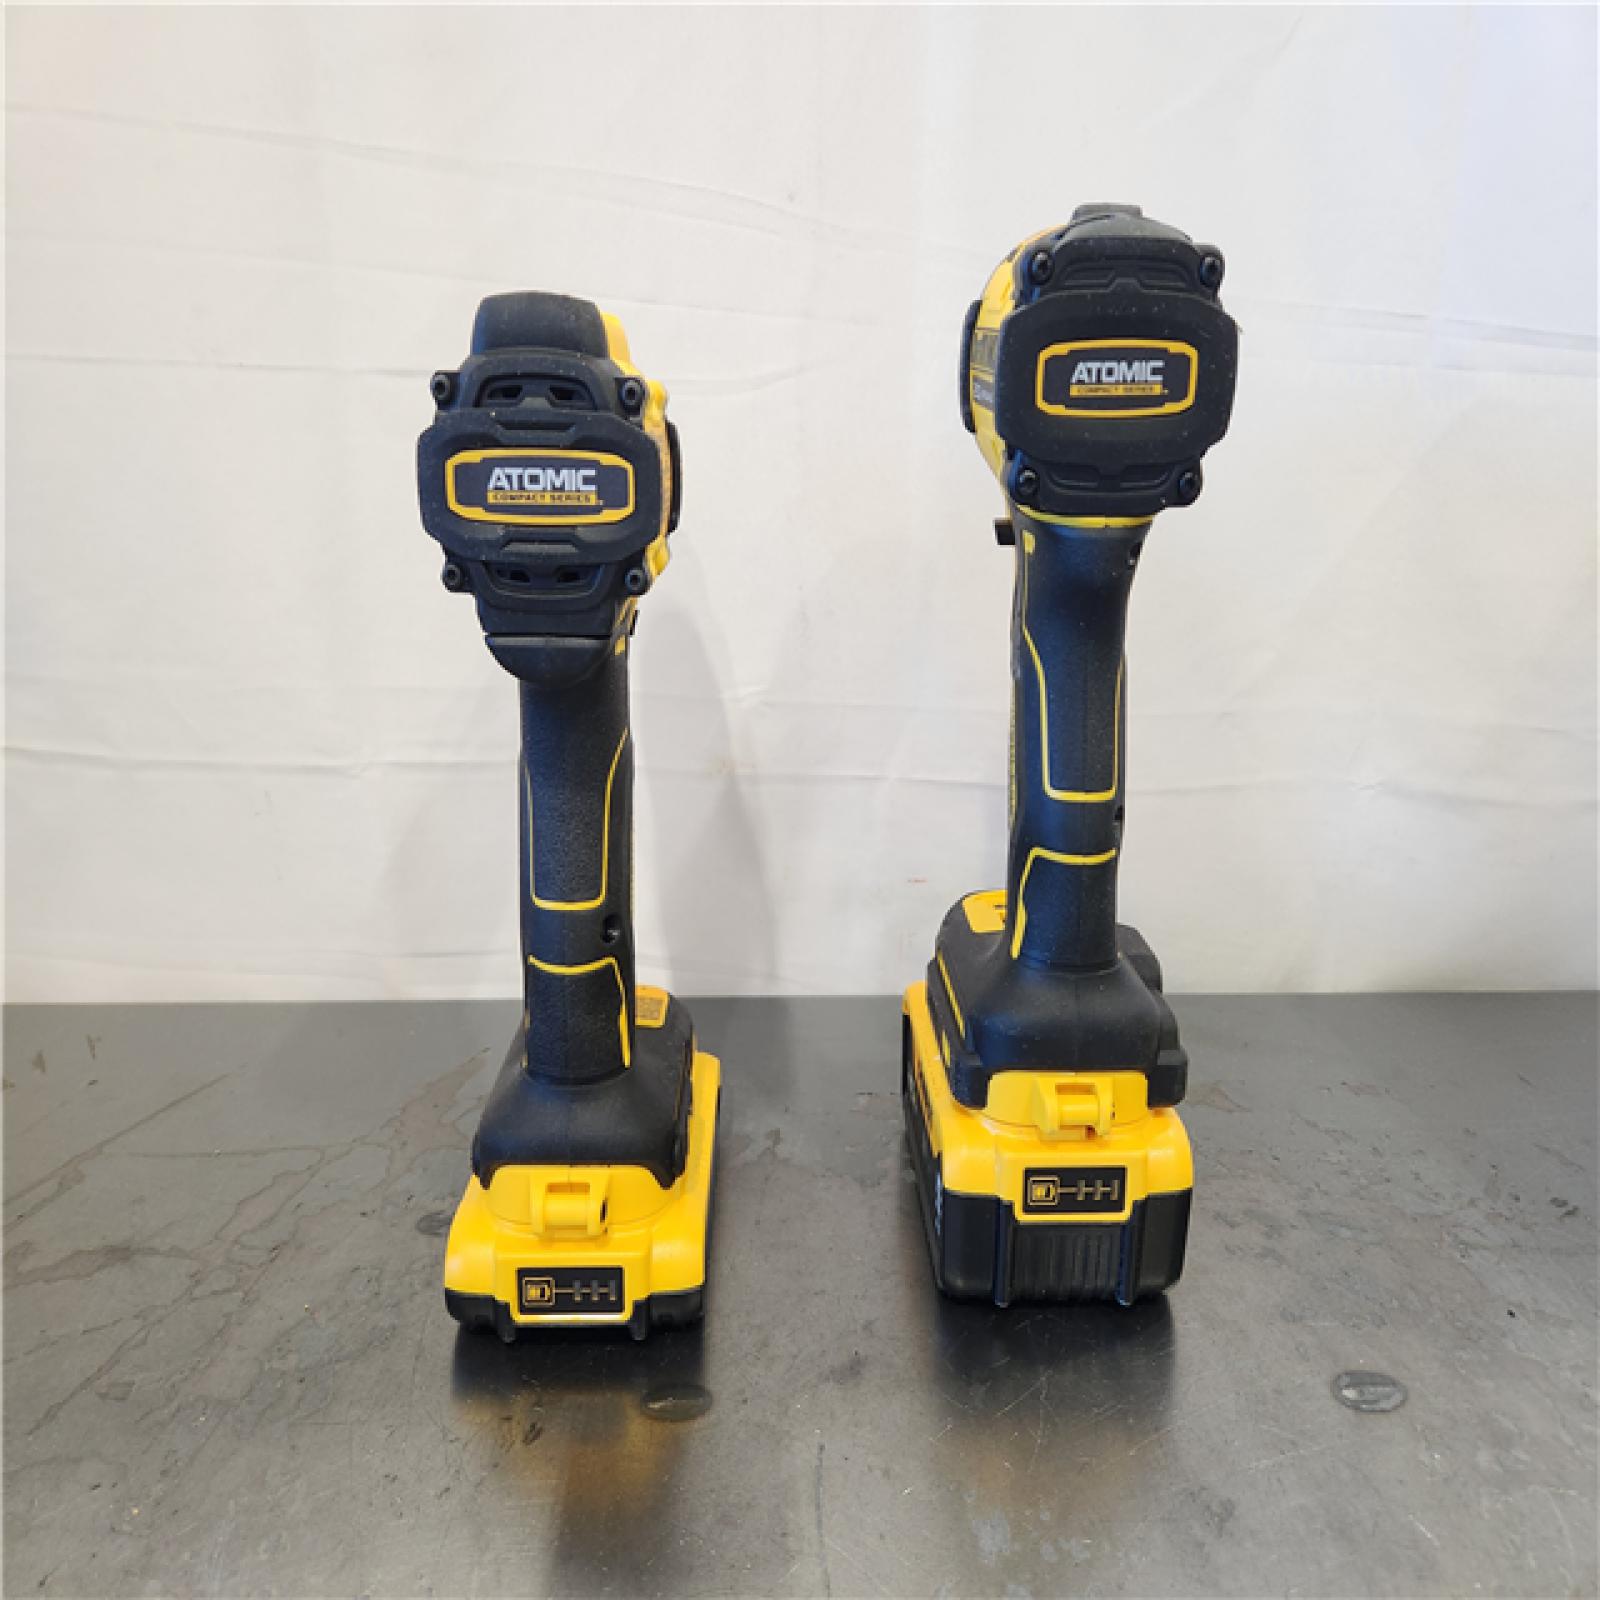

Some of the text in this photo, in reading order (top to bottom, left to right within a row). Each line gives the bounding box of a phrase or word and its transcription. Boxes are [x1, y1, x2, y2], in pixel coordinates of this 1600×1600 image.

[1071, 360, 1164, 383] ATOMIC
[487, 467, 596, 491] ATOMIC
[493, 494, 592, 503] COMPACT SERIES
